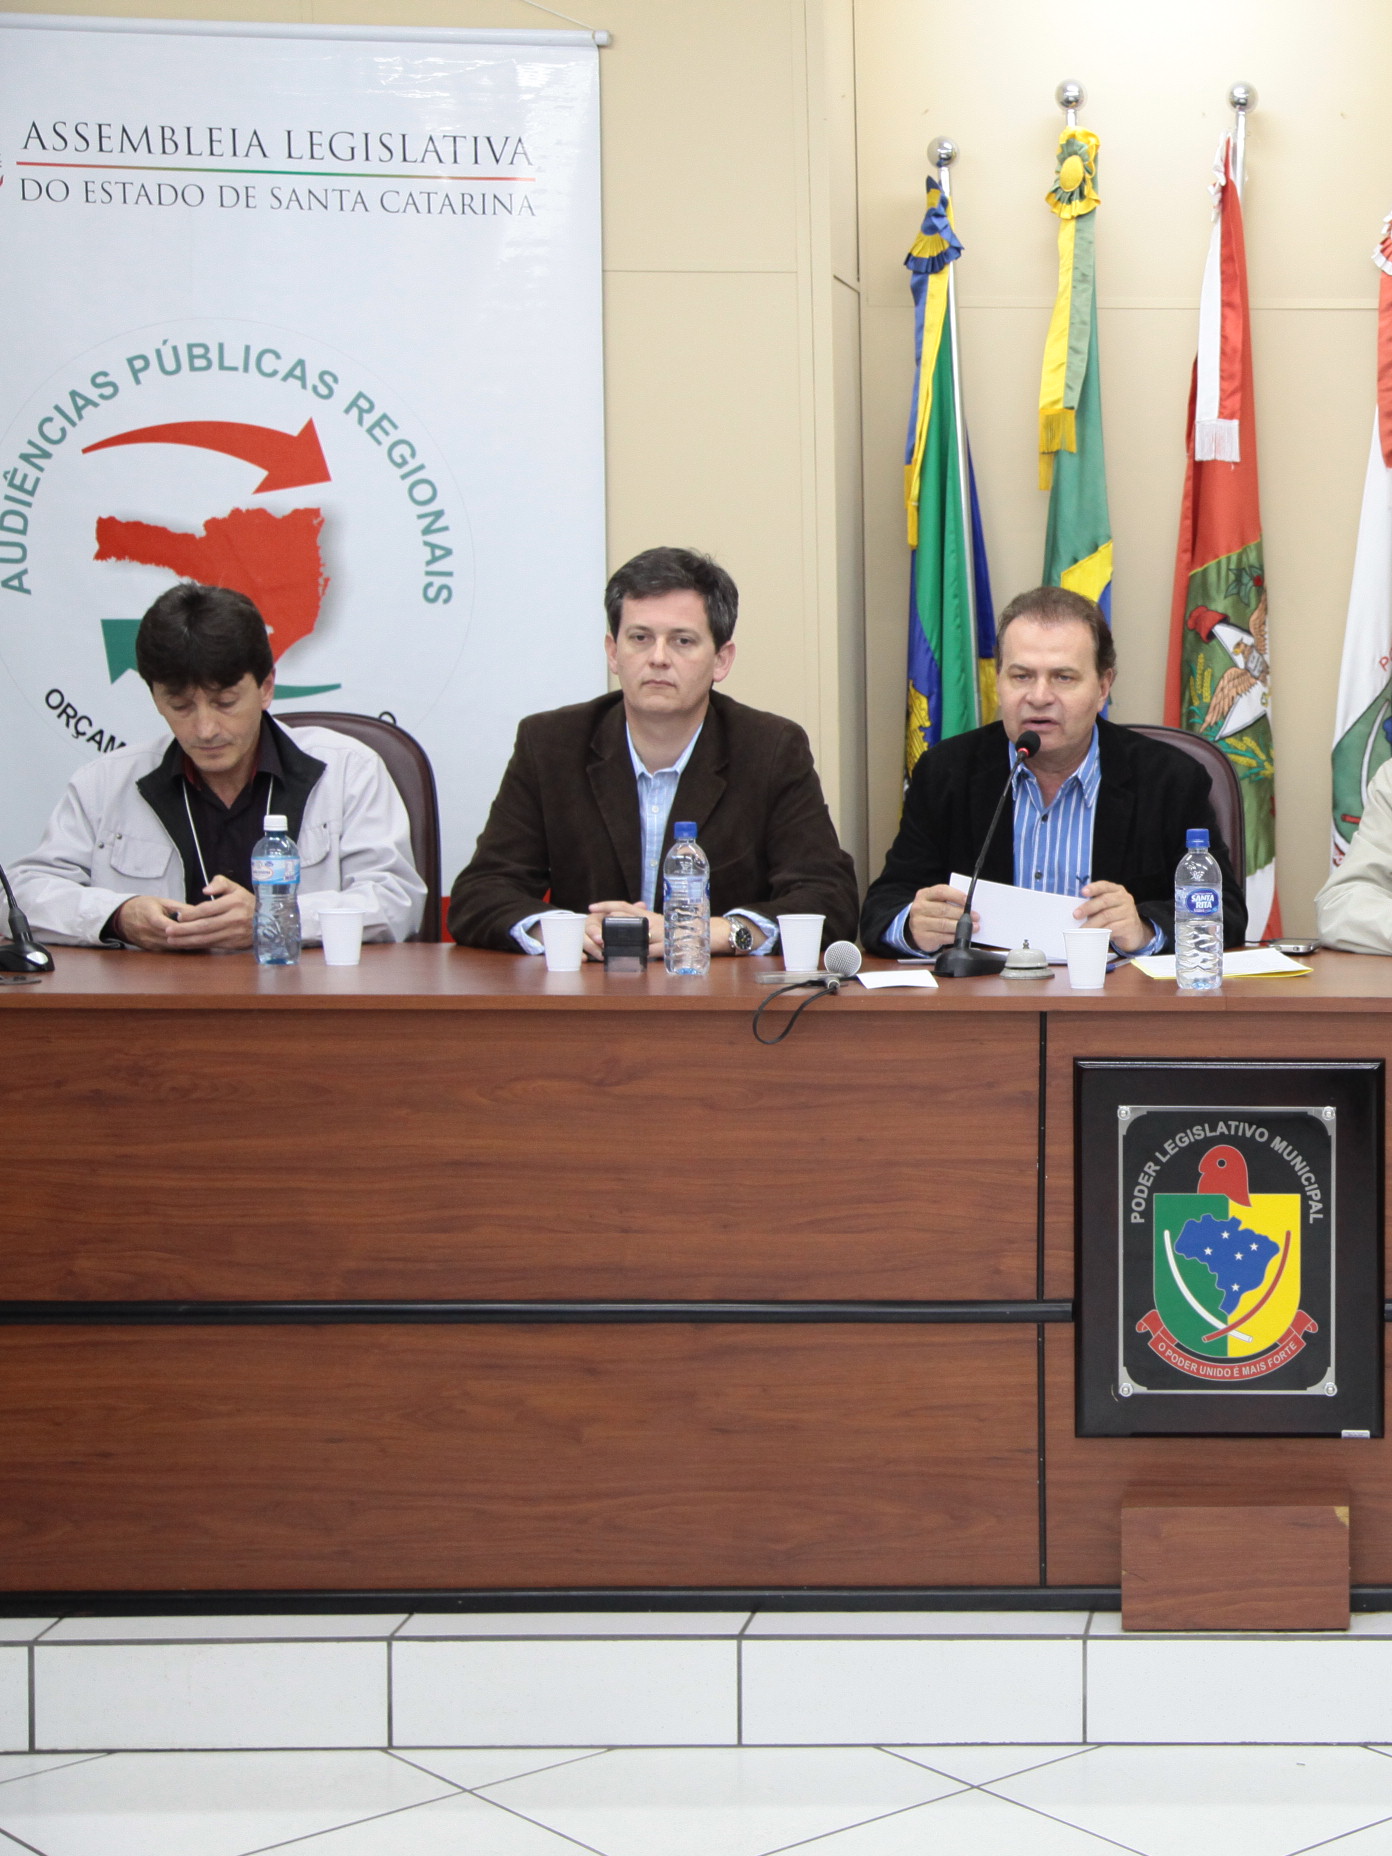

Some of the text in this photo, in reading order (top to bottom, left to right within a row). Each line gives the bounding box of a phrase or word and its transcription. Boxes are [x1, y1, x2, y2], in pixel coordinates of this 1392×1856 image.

[22, 119, 535, 167] ASSEMBLEIA LEGISLATIVA
[20, 177, 537, 217] DO ESTADO DE SANTA CATARINA
[0, 338, 454, 605] AUDIÊNCIAS PÚBLICAS REGIONAIS
[45, 688, 127, 754] ORÇAM
[1191, 894, 1215, 902] SANTA
[1195, 901, 1213, 909] RITA
[1130, 1121, 1323, 1224] PODER LEGISLATIVO MUNICIPAL
[1158, 1342, 1166, 1351] O
[1165, 1347, 1198, 1372] PODER
[1200, 1366, 1231, 1377] UNIDO
[1242, 1362, 1266, 1375] MAIS
[1267, 1341, 1298, 1367] FORTE
